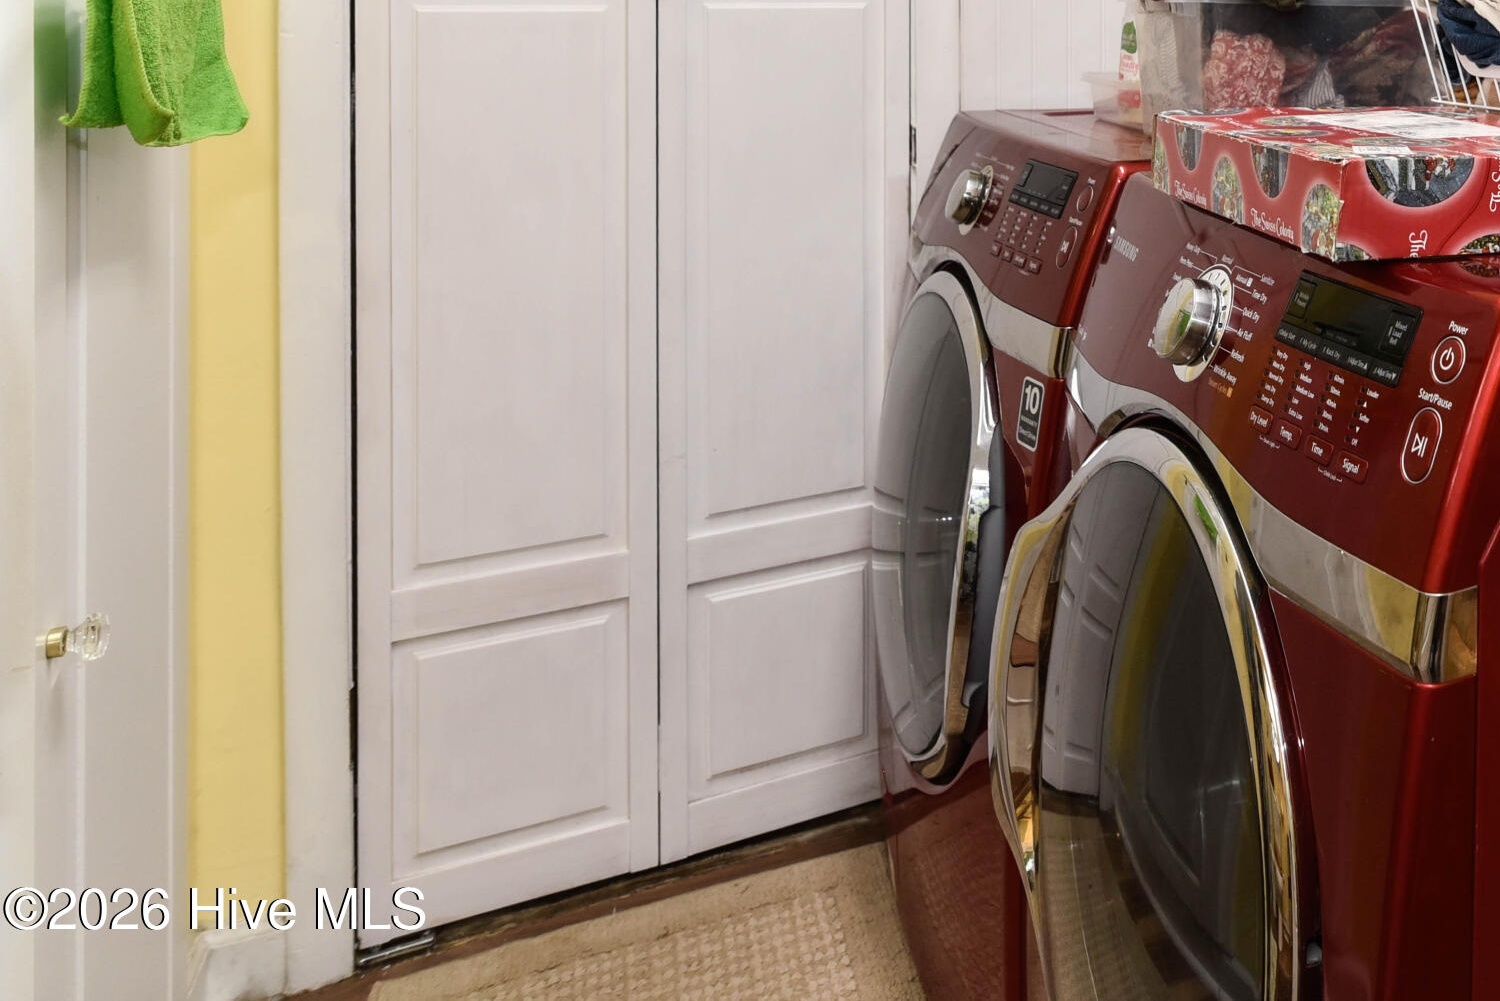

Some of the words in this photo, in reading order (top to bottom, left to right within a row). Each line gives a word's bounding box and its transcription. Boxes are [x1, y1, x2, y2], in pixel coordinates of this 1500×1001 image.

[1251, 207, 1261, 227] The
[1262, 212, 1276, 233] Swiss
[1276, 217, 1294, 244] Colony
[1114, 235, 1139, 262] SAMSUNG
[1448, 320, 1468, 335] Power
[1025, 385, 1040, 415] 10
[1418, 388, 1452, 410] Start/Pause
[1250, 411, 1258, 424] Dry
[1257, 414, 1268, 427] Level
[1312, 442, 1324, 456] Time
[1342, 458, 1360, 474] Signal
